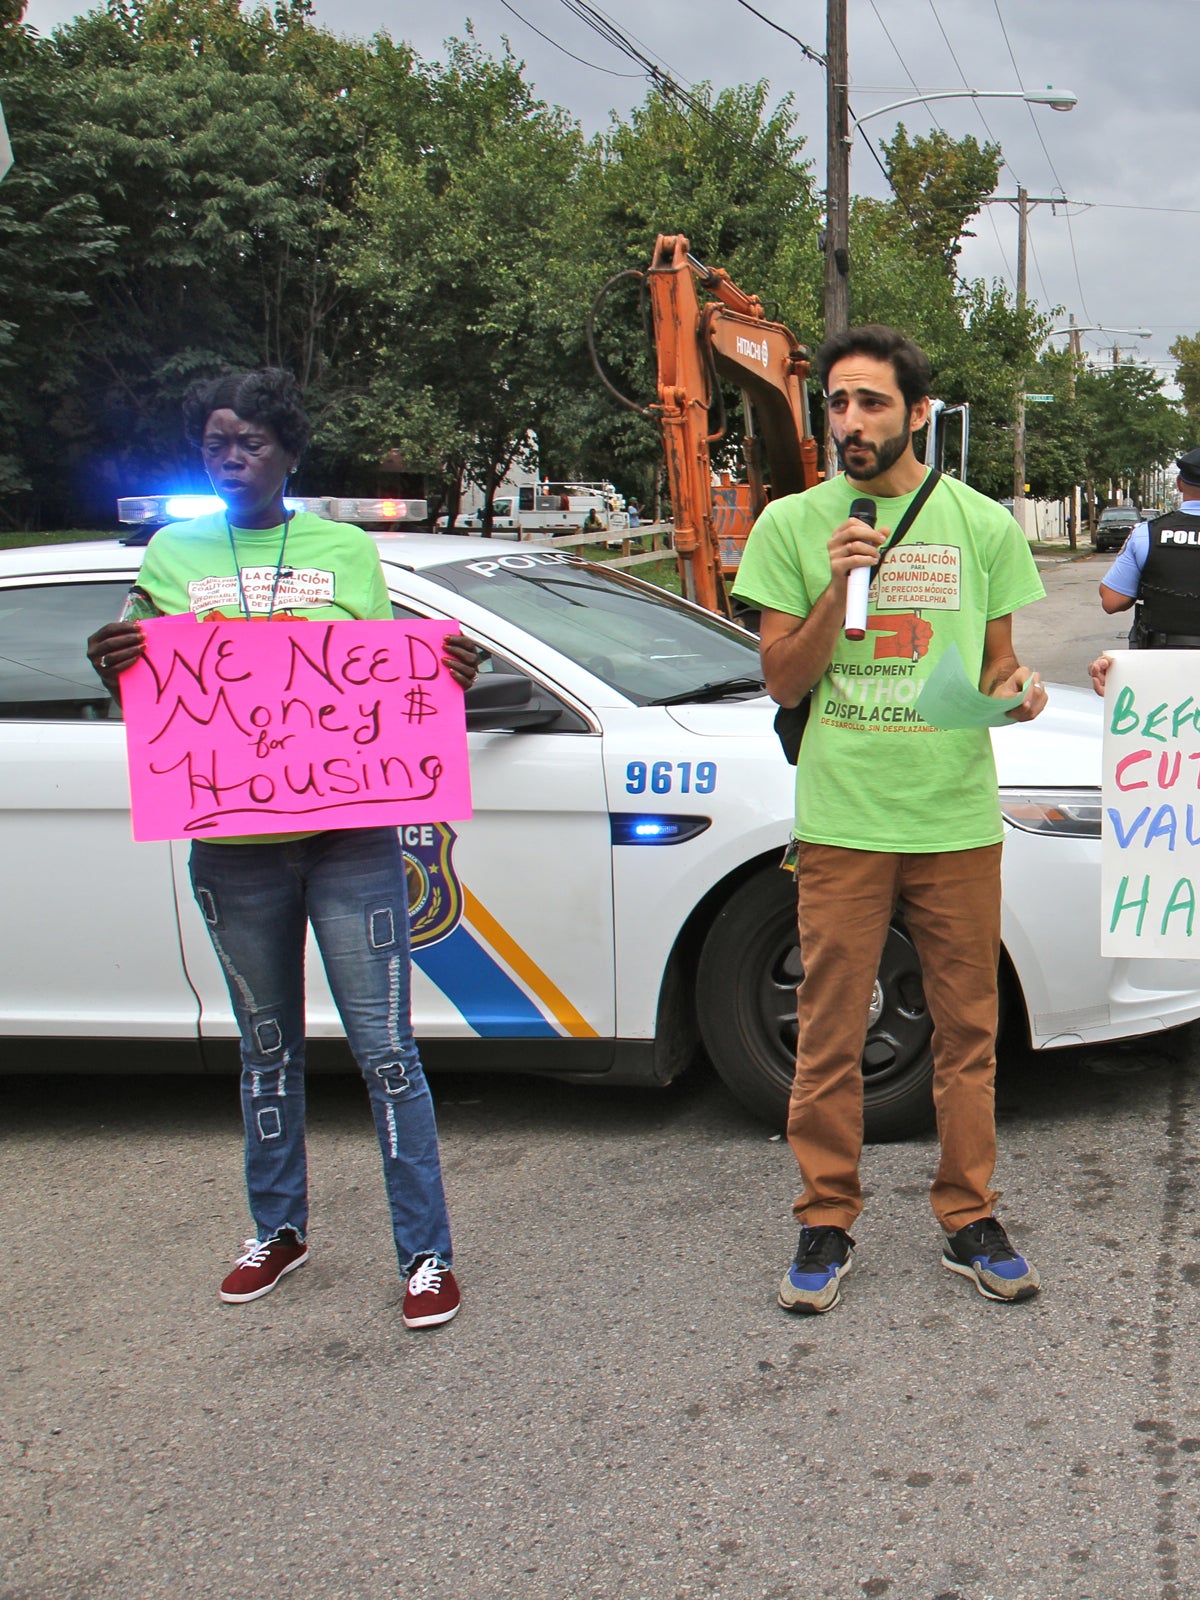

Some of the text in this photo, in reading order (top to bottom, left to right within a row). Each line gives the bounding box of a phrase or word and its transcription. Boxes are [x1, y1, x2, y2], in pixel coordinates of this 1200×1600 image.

[736, 335, 761, 361] HITACHI
[900, 550, 957, 565] COALICIÓN
[465, 554, 596, 578] POLIC
[245, 572, 261, 580] LA
[882, 571, 958, 583] COMUNIDADES
[192, 583, 237, 592] COALITION
[892, 585, 923, 593] PRECIOS
[925, 583, 957, 595] MÓDICOS
[898, 595, 947, 604] FILADELPHIA
[139, 625, 440, 704] WE NEED
[827, 663, 916, 676] DEVELOPMENT
[148, 684, 438, 745] Money $
[868, 724, 880, 732] SIN
[248, 729, 296, 758] for
[150, 750, 443, 810] Housing
[625, 761, 717, 794] 9619
